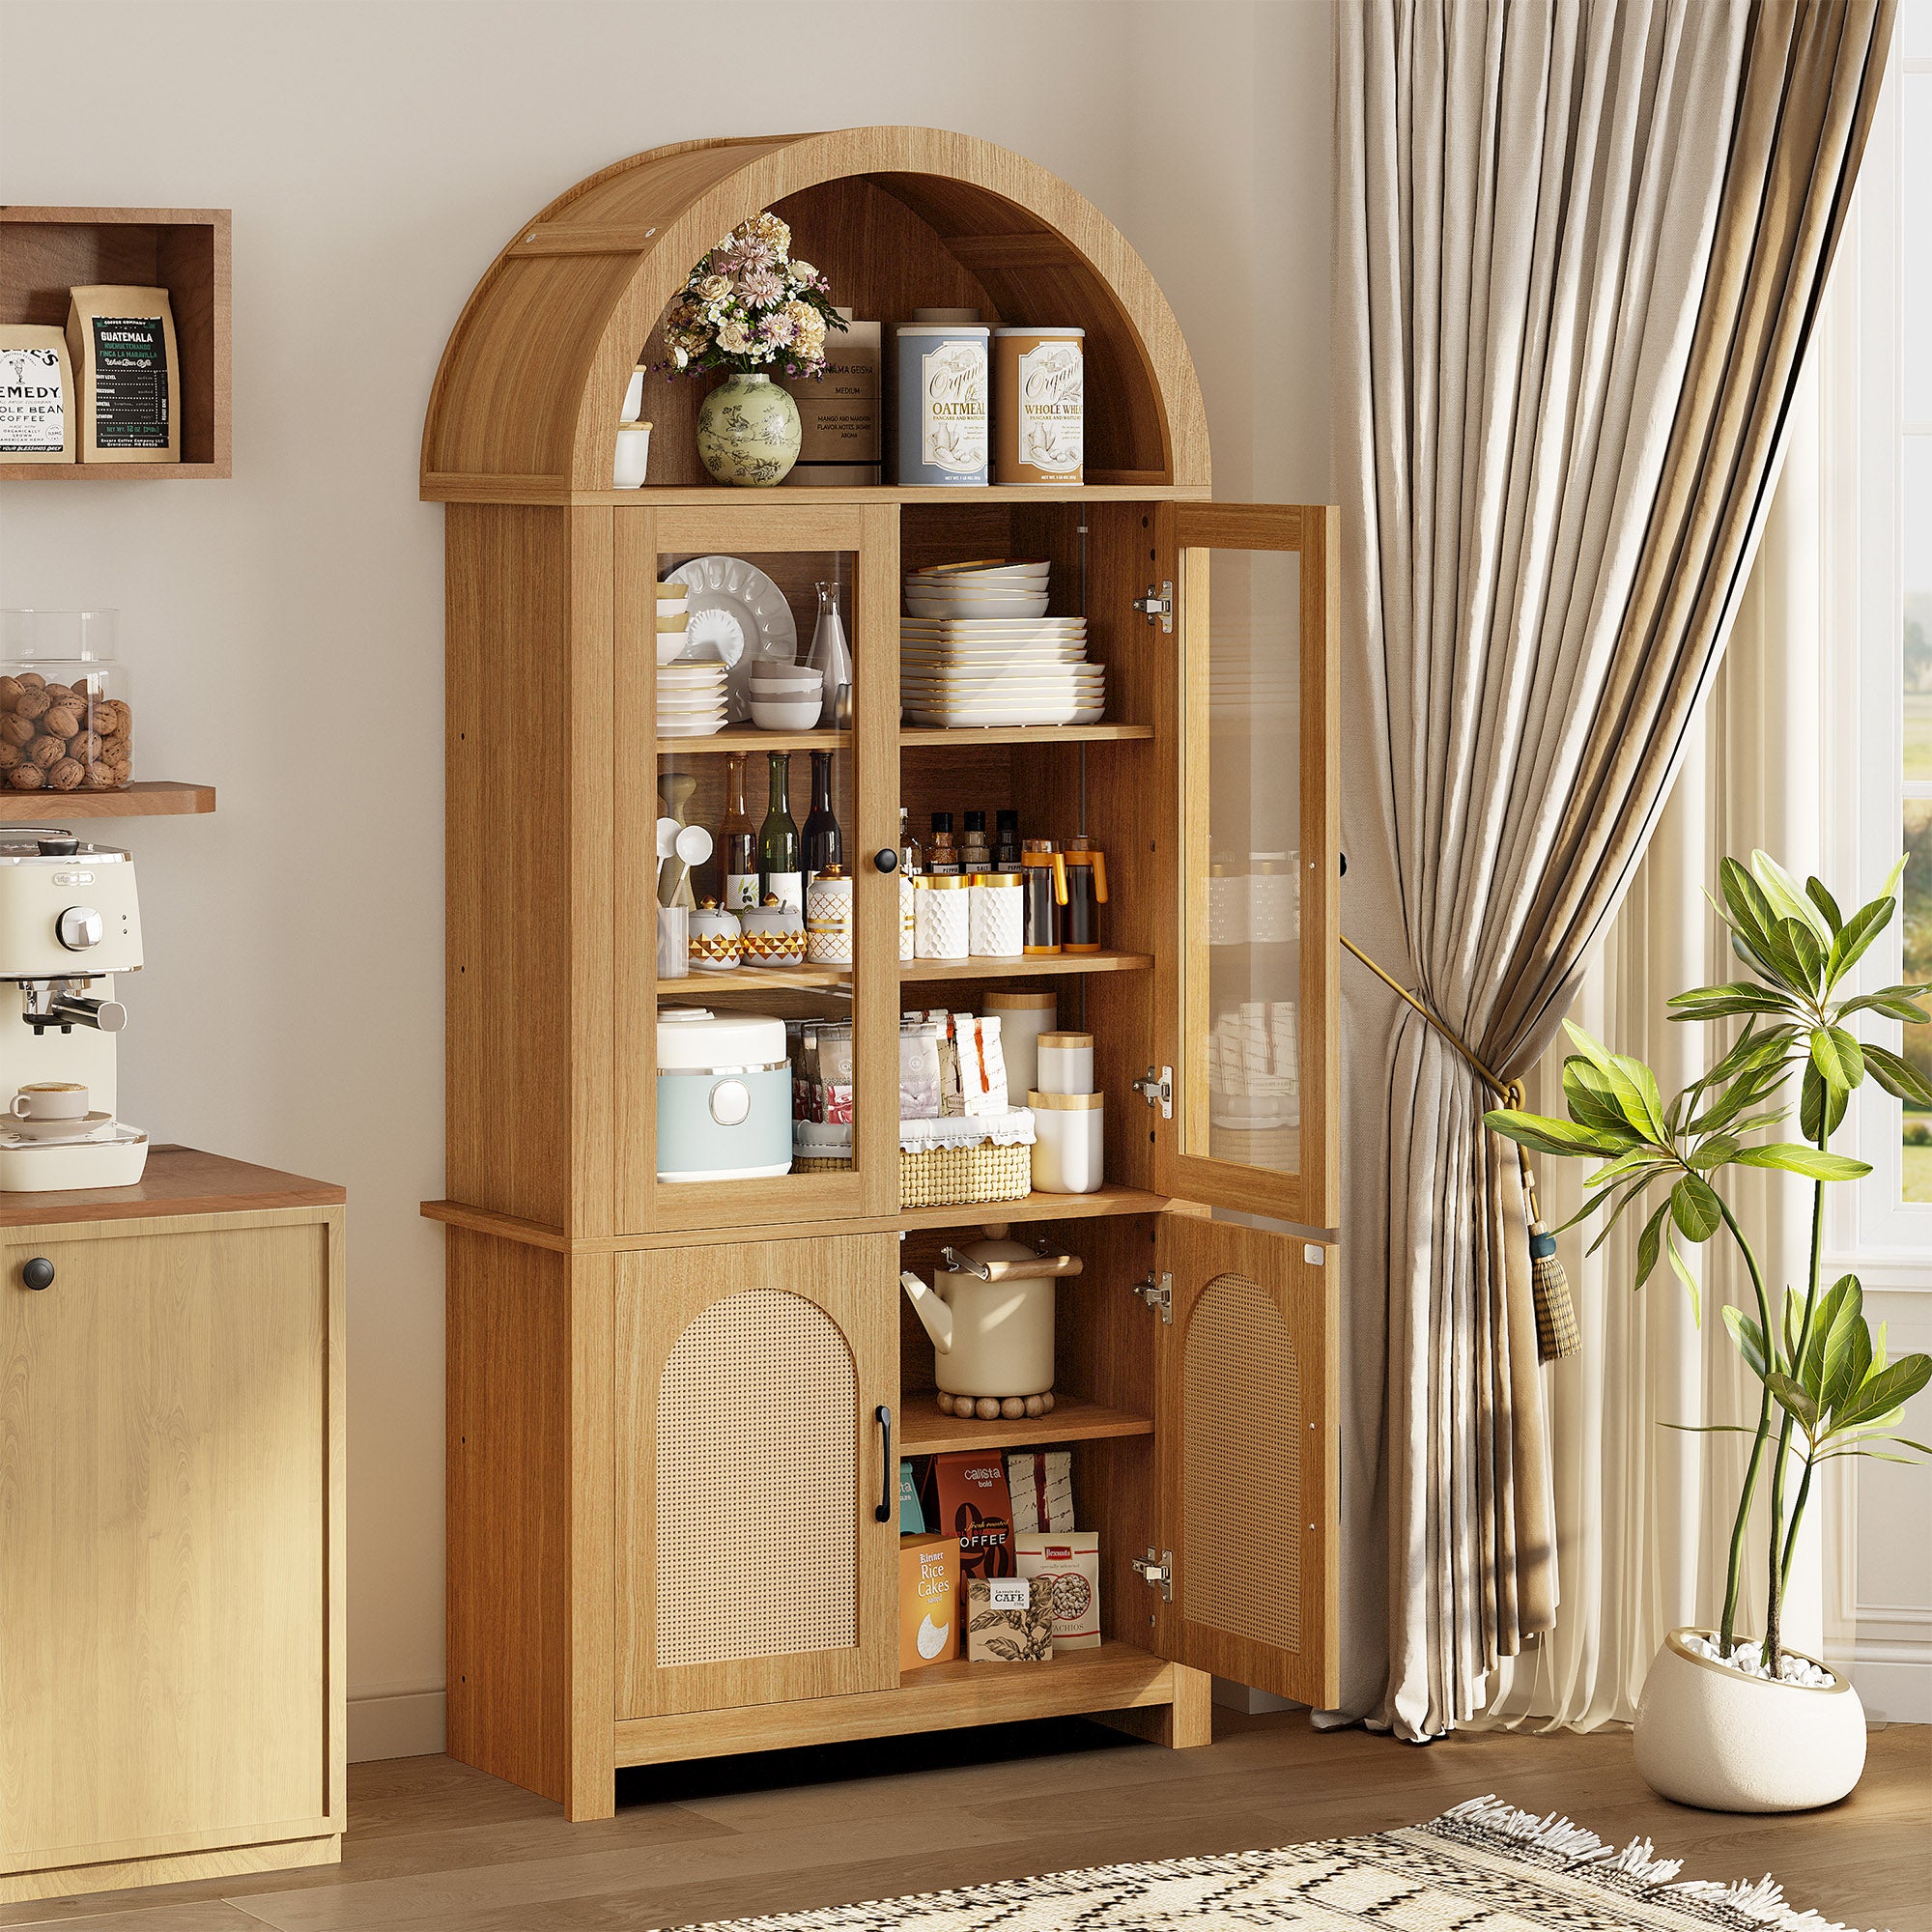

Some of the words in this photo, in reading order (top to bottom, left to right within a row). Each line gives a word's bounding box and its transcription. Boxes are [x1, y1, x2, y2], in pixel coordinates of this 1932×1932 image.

[100, 331, 154, 342] GUATEMALA
[851, 366, 873, 375] GEISHA
[29, 404, 64, 413] BEAN
[932, 402, 985, 415] OATMEAL
[1025, 405, 1061, 414] WHOLE
[959, 1533, 1006, 1548] OFFEE
[922, 1564, 945, 1580] Rice
[917, 1577, 950, 1597] Cakes
